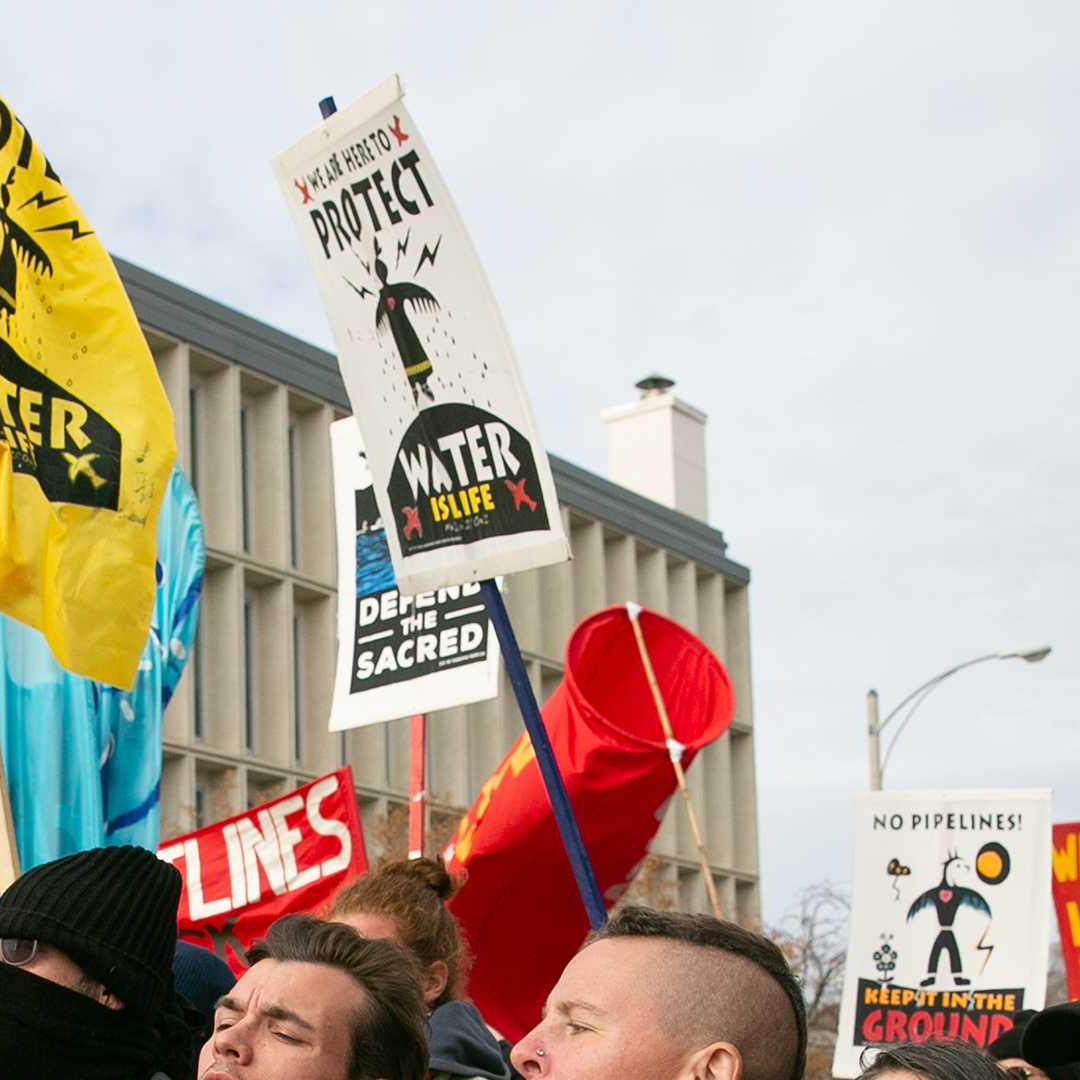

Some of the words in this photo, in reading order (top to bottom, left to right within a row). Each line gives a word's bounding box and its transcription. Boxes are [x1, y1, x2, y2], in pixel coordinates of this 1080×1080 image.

[306, 167, 327, 193] WE
[324, 153, 343, 185] ARE
[341, 138, 375, 172] HERE
[369, 128, 391, 155] TO
[309, 149, 434, 259] PROTECT
[398, 421, 521, 503] WATER
[356, 622, 483, 679] SACRED
[400, 609, 438, 636] THE
[157, 775, 352, 921] LINES
[873, 813, 904, 831] NO
[911, 813, 1023, 831] PIPELINES!
[864, 987, 916, 1006] KEEP
[918, 990, 938, 1007] IT
[941, 992, 968, 1009] IN
[973, 992, 1016, 1012] THE
[861, 1009, 1015, 1048] GROUND
